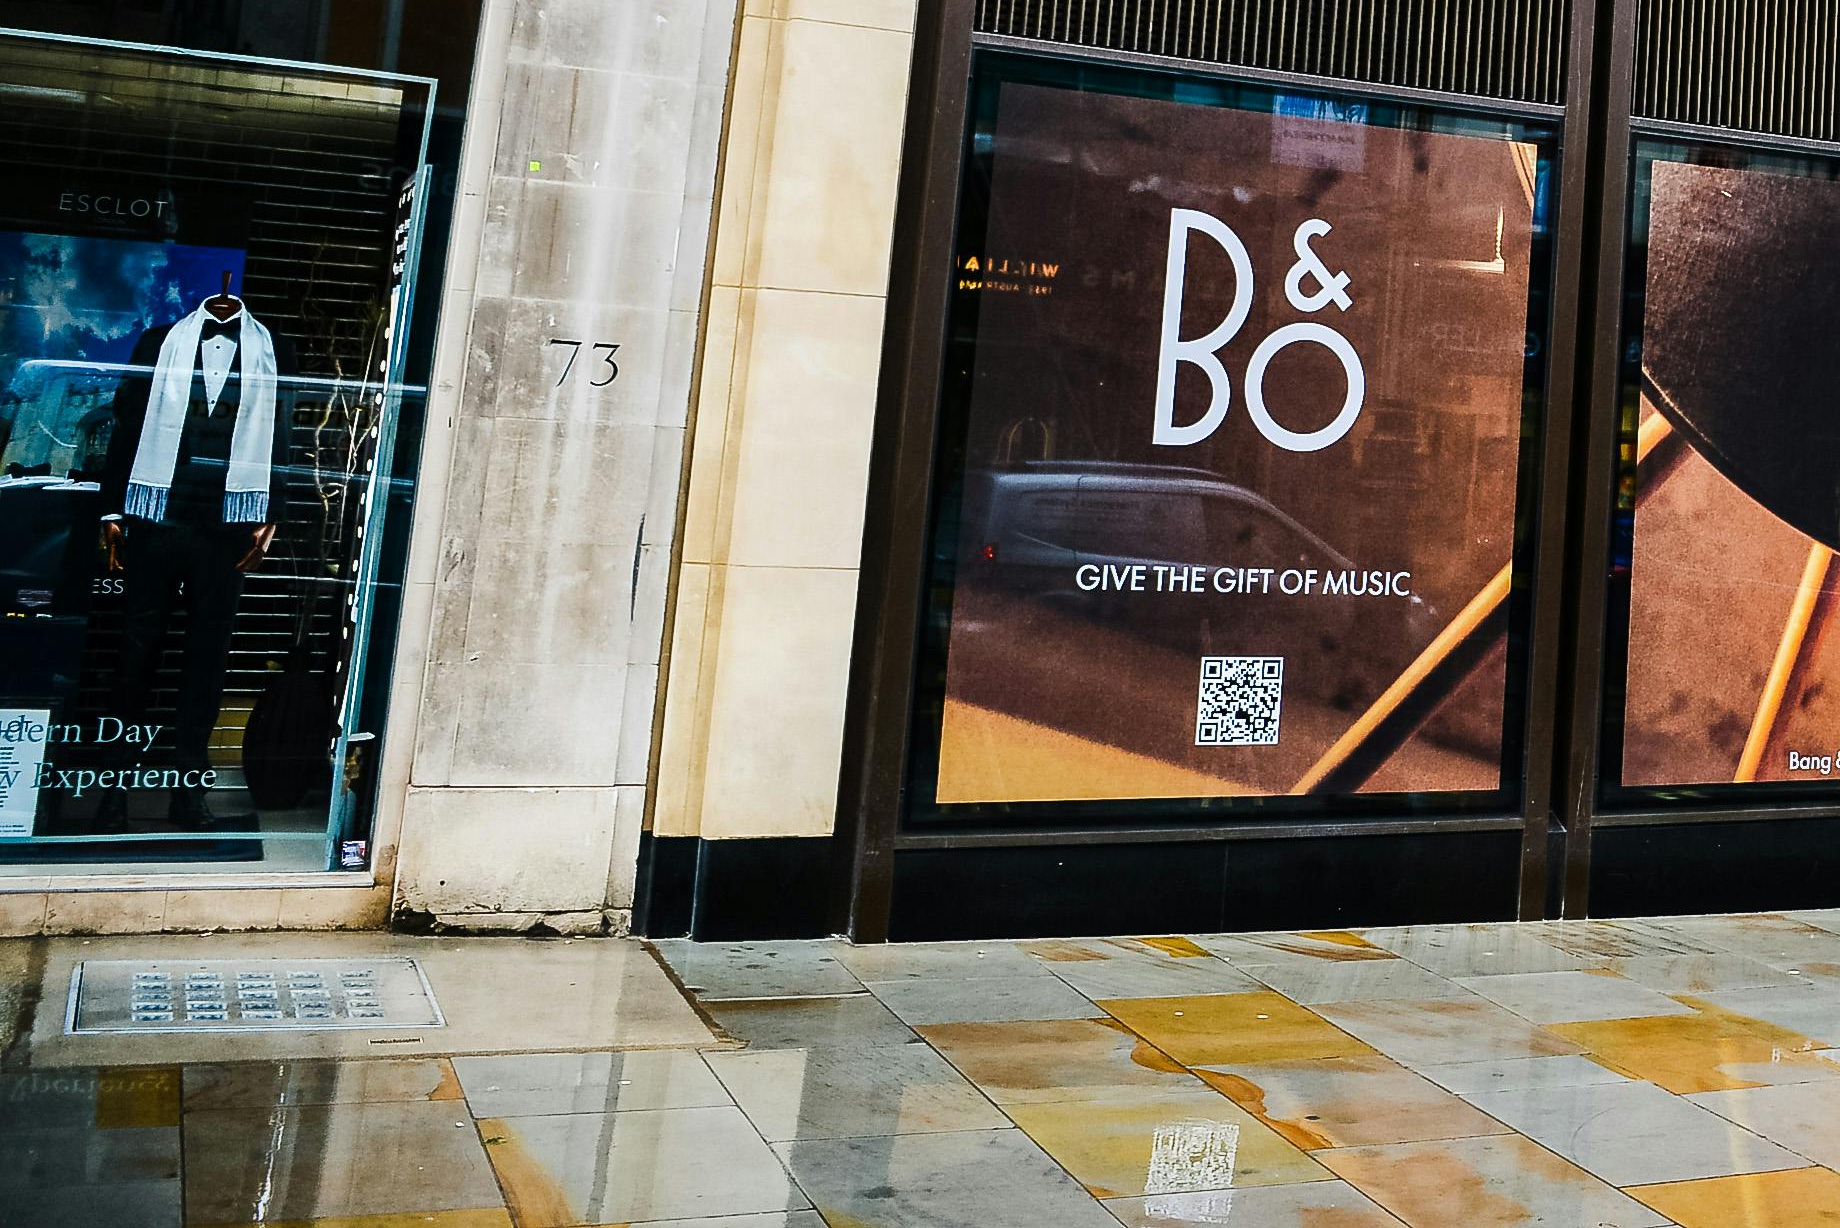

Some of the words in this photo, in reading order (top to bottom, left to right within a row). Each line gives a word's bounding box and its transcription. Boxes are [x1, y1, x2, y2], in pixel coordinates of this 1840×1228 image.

[550, 338, 621, 387] 73
[1076, 564, 1147, 591] GIVE
[1152, 565, 1207, 593] THE
[1213, 567, 1275, 594] GIFT
[1279, 569, 1318, 595] OF
[1322, 570, 1411, 597] MUSIC
[94, 716, 164, 752] Day
[30, 762, 217, 798] Experience
[1789, 751, 1832, 775] Bang
